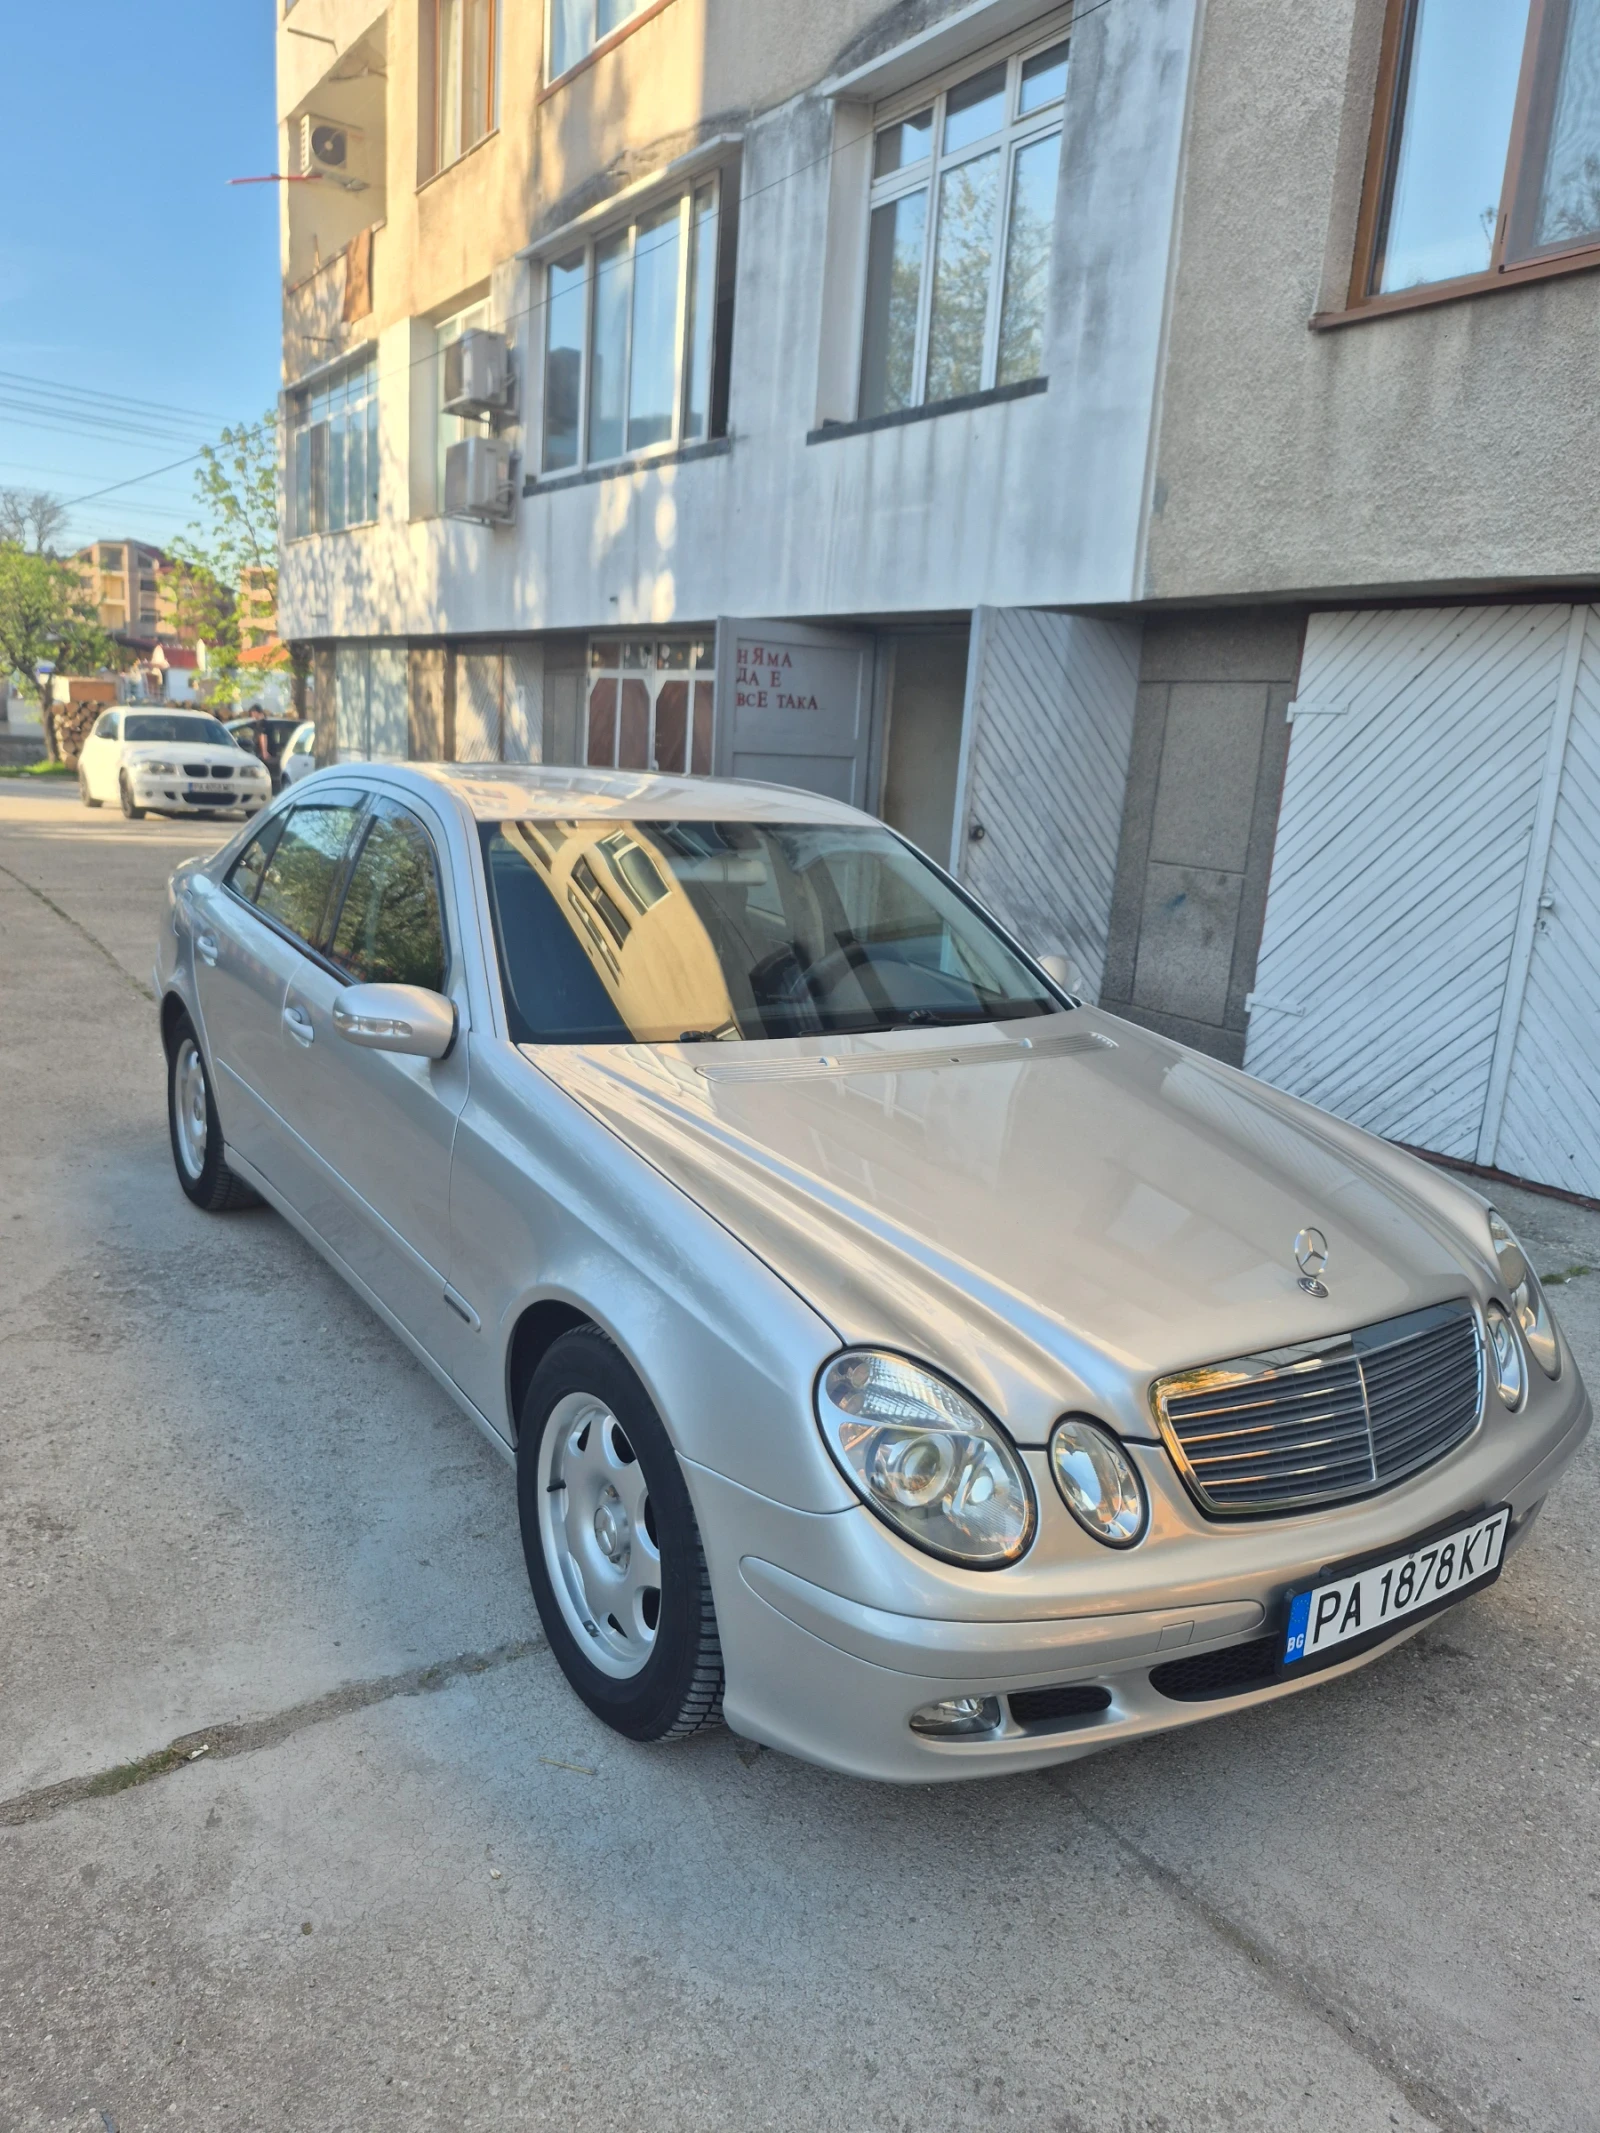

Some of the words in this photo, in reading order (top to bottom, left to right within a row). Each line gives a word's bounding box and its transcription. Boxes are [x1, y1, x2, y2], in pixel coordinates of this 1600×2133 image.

[735, 667, 759, 686] ДА
[770, 671, 781, 687] Е
[736, 691, 768, 708] ВСЕ
[777, 693, 818, 710] ТАКА
[1313, 1581, 1361, 1644] PA
[1380, 1543, 1455, 1617] 1878
[1459, 1519, 1502, 1580] KT
[1287, 1633, 1305, 1651] BG
